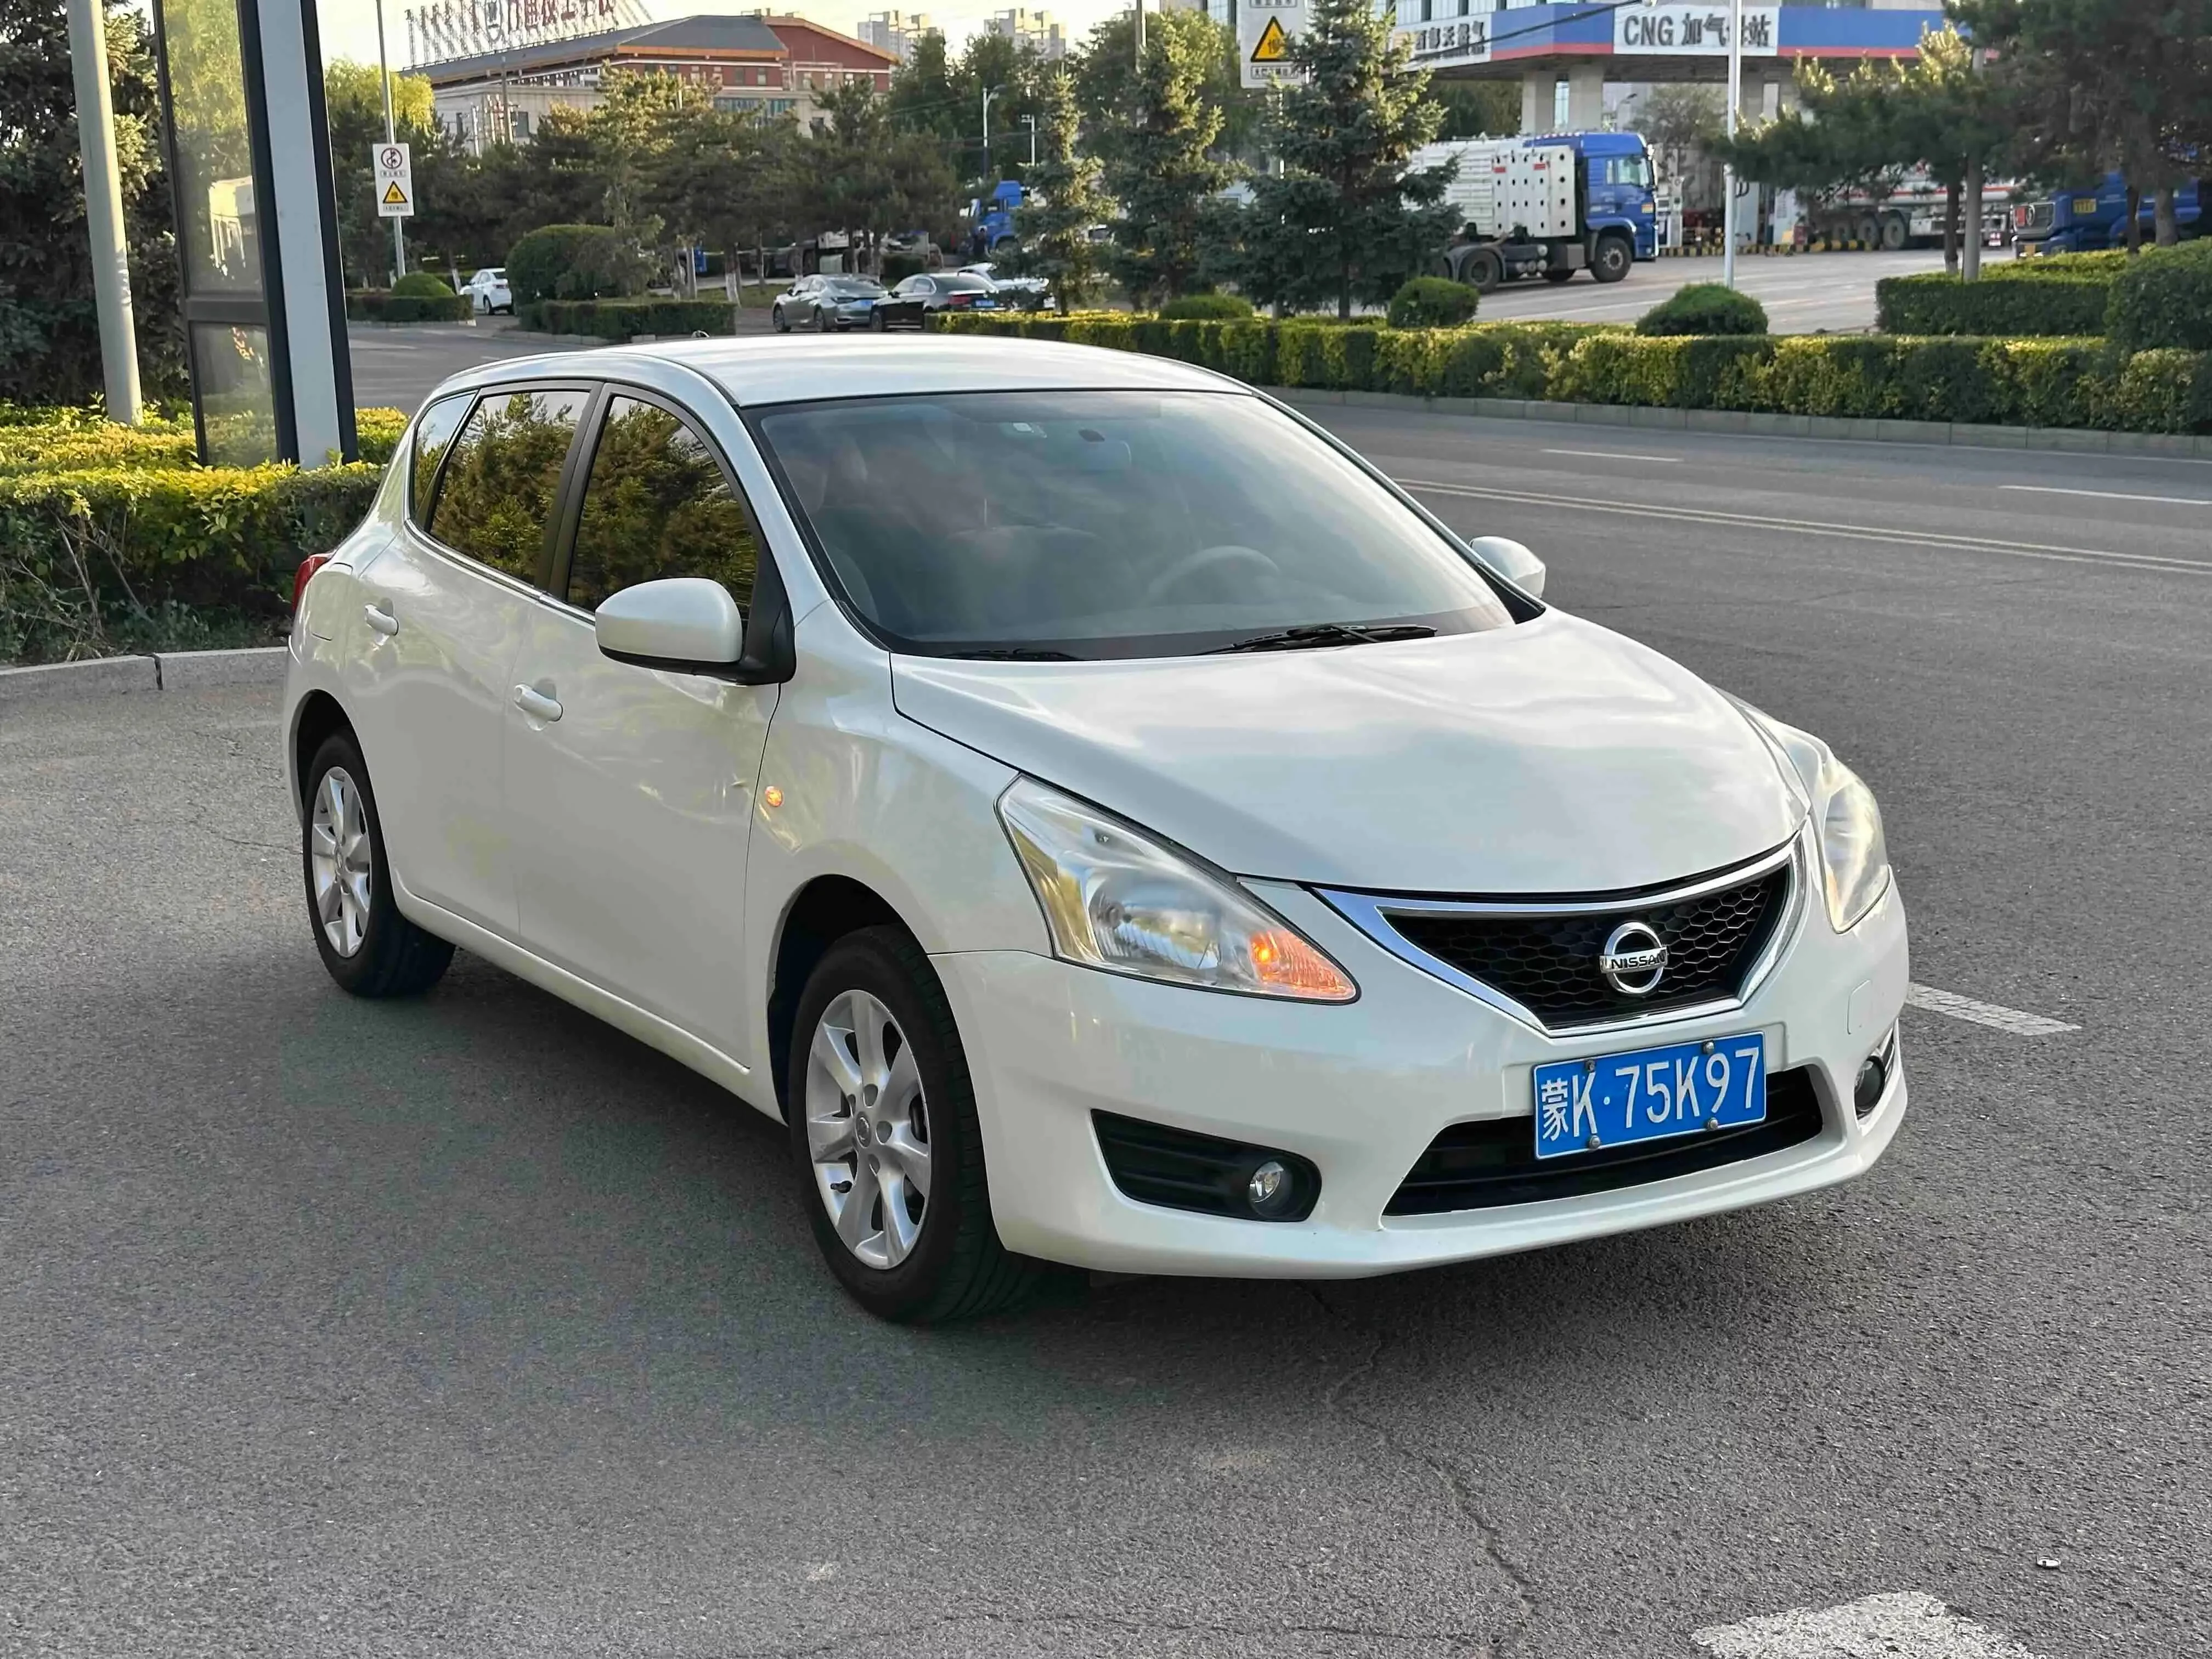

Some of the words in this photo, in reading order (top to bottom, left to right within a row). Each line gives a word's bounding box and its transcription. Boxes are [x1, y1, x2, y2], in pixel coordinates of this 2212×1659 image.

[1624, 15, 1674, 46] CNG
[1610, 951, 1666, 970] NISSAN
[1541, 1046, 1760, 1141] 蒙K·75K97
